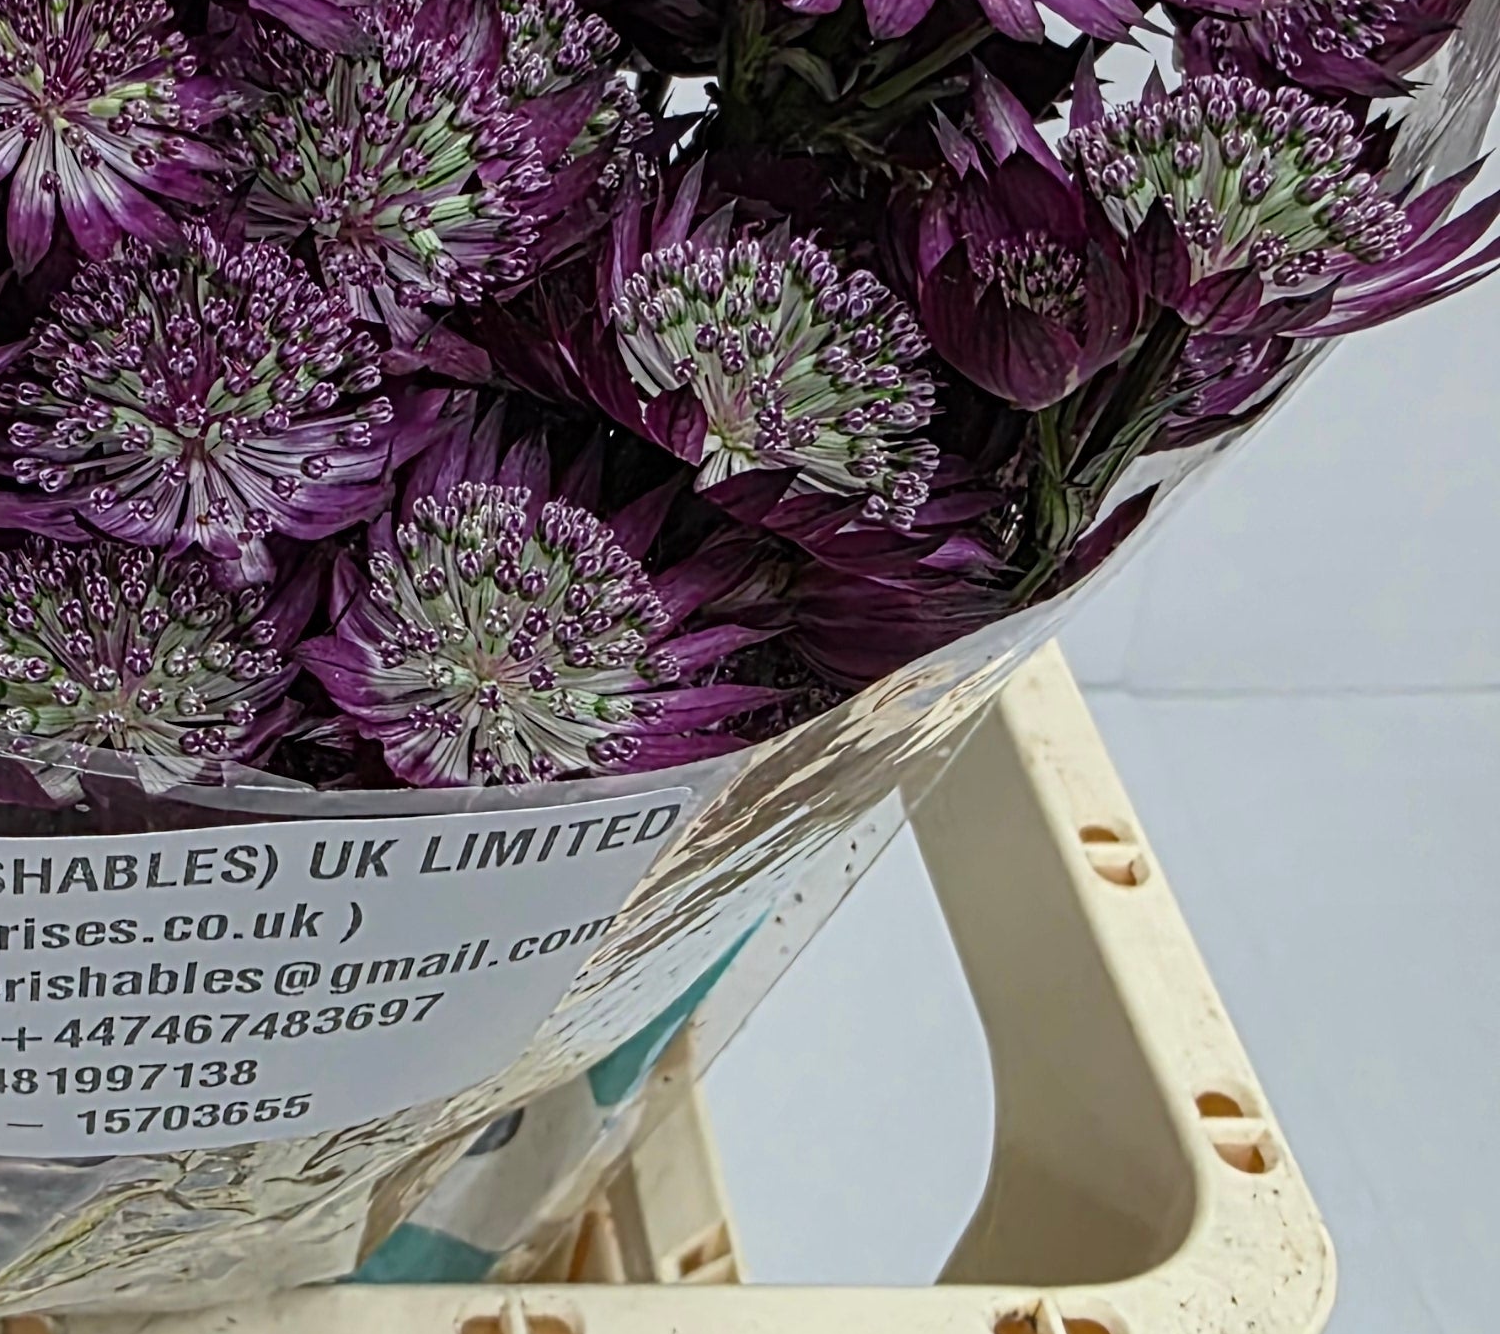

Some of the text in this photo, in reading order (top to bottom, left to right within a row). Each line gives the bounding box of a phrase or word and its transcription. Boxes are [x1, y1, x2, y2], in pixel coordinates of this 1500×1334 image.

[310, 838, 399, 880] UK
[419, 803, 682, 874] LIMITED
[2, 992, 445, 1052] +447467483697
[77, 1093, 311, 1136] 15703655
